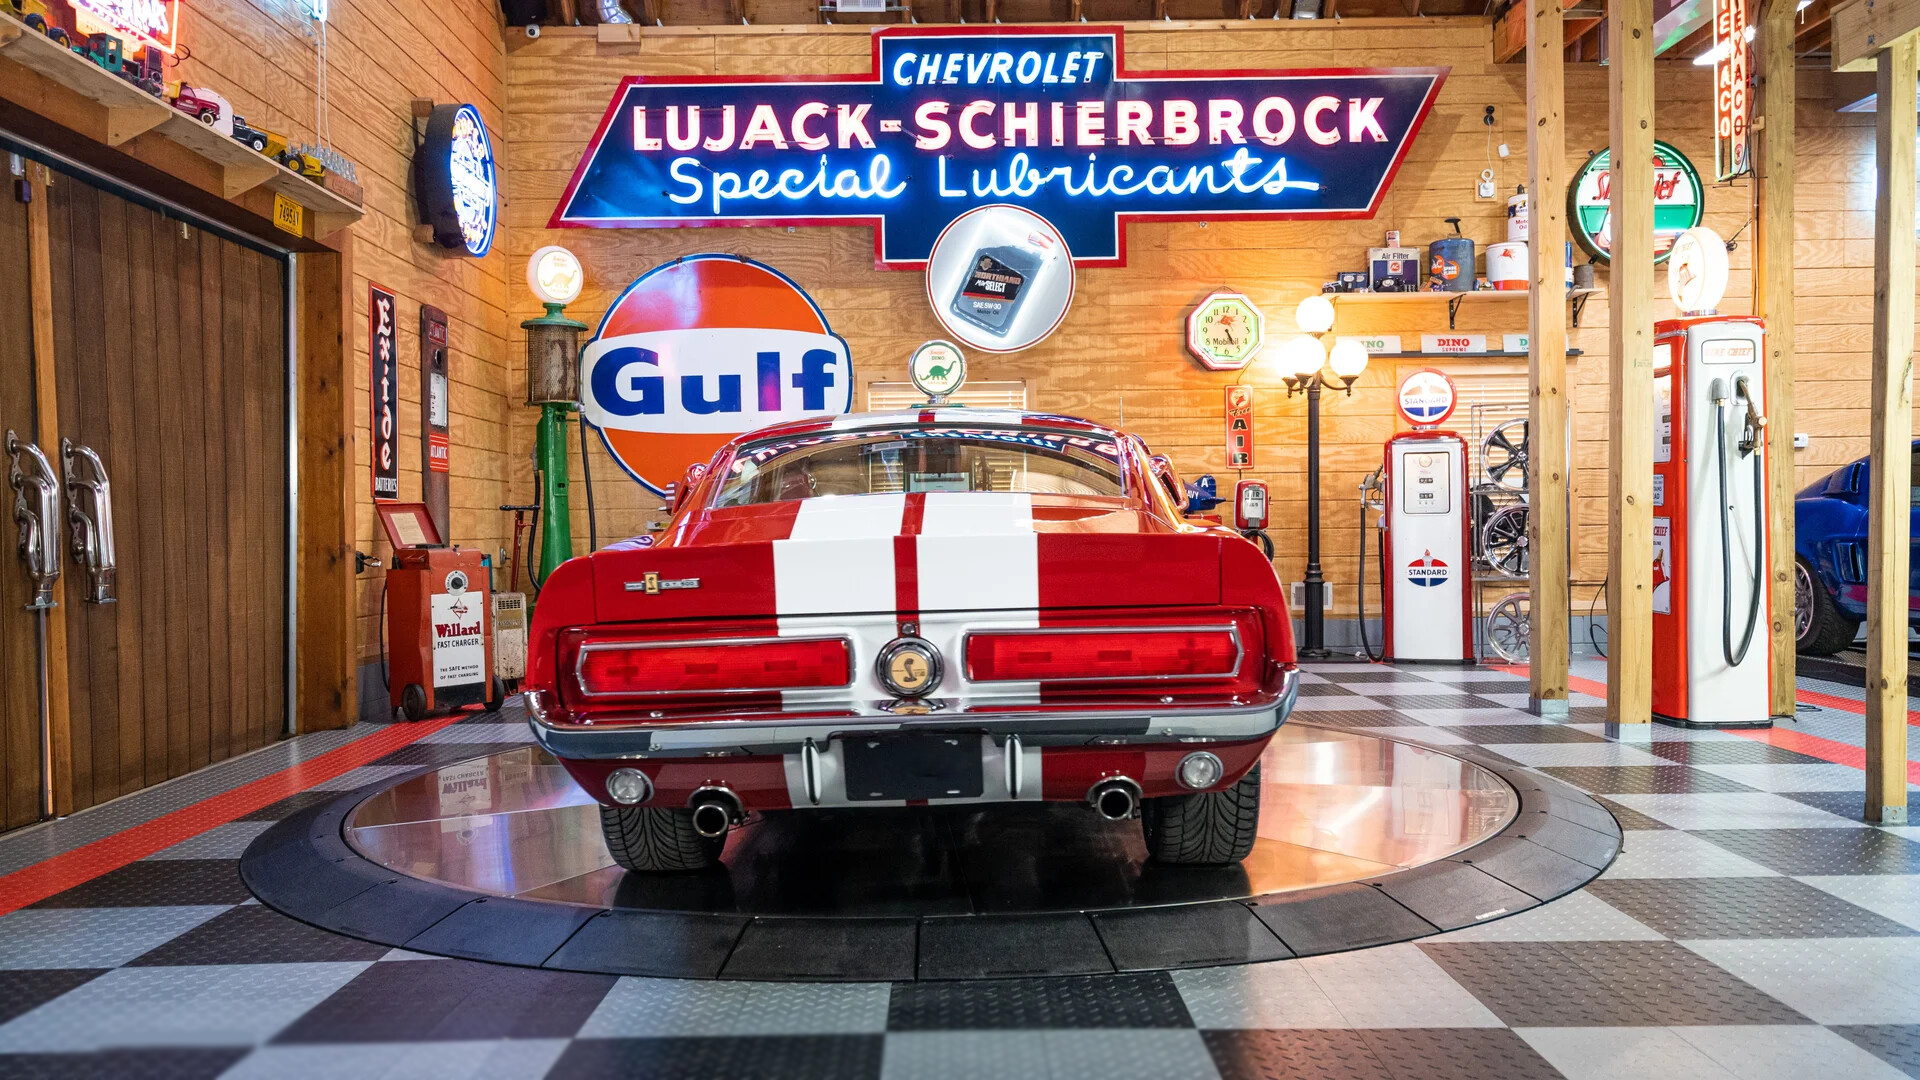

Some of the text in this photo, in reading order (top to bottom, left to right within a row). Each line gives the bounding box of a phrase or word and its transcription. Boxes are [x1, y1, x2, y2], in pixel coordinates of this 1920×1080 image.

[893, 50, 1105, 86] CHEVROLET
[667, 153, 908, 214] Special
[938, 147, 1322, 198] Lubricants
[1381, 252, 1409, 260] Air Filter
[1437, 338, 1471, 347] DINO
[591, 347, 837, 417] Gulf
[1232, 418, 1248, 464] AIR
[434, 621, 481, 638] Willard
[437, 638, 480, 649] FAST CHARGER
